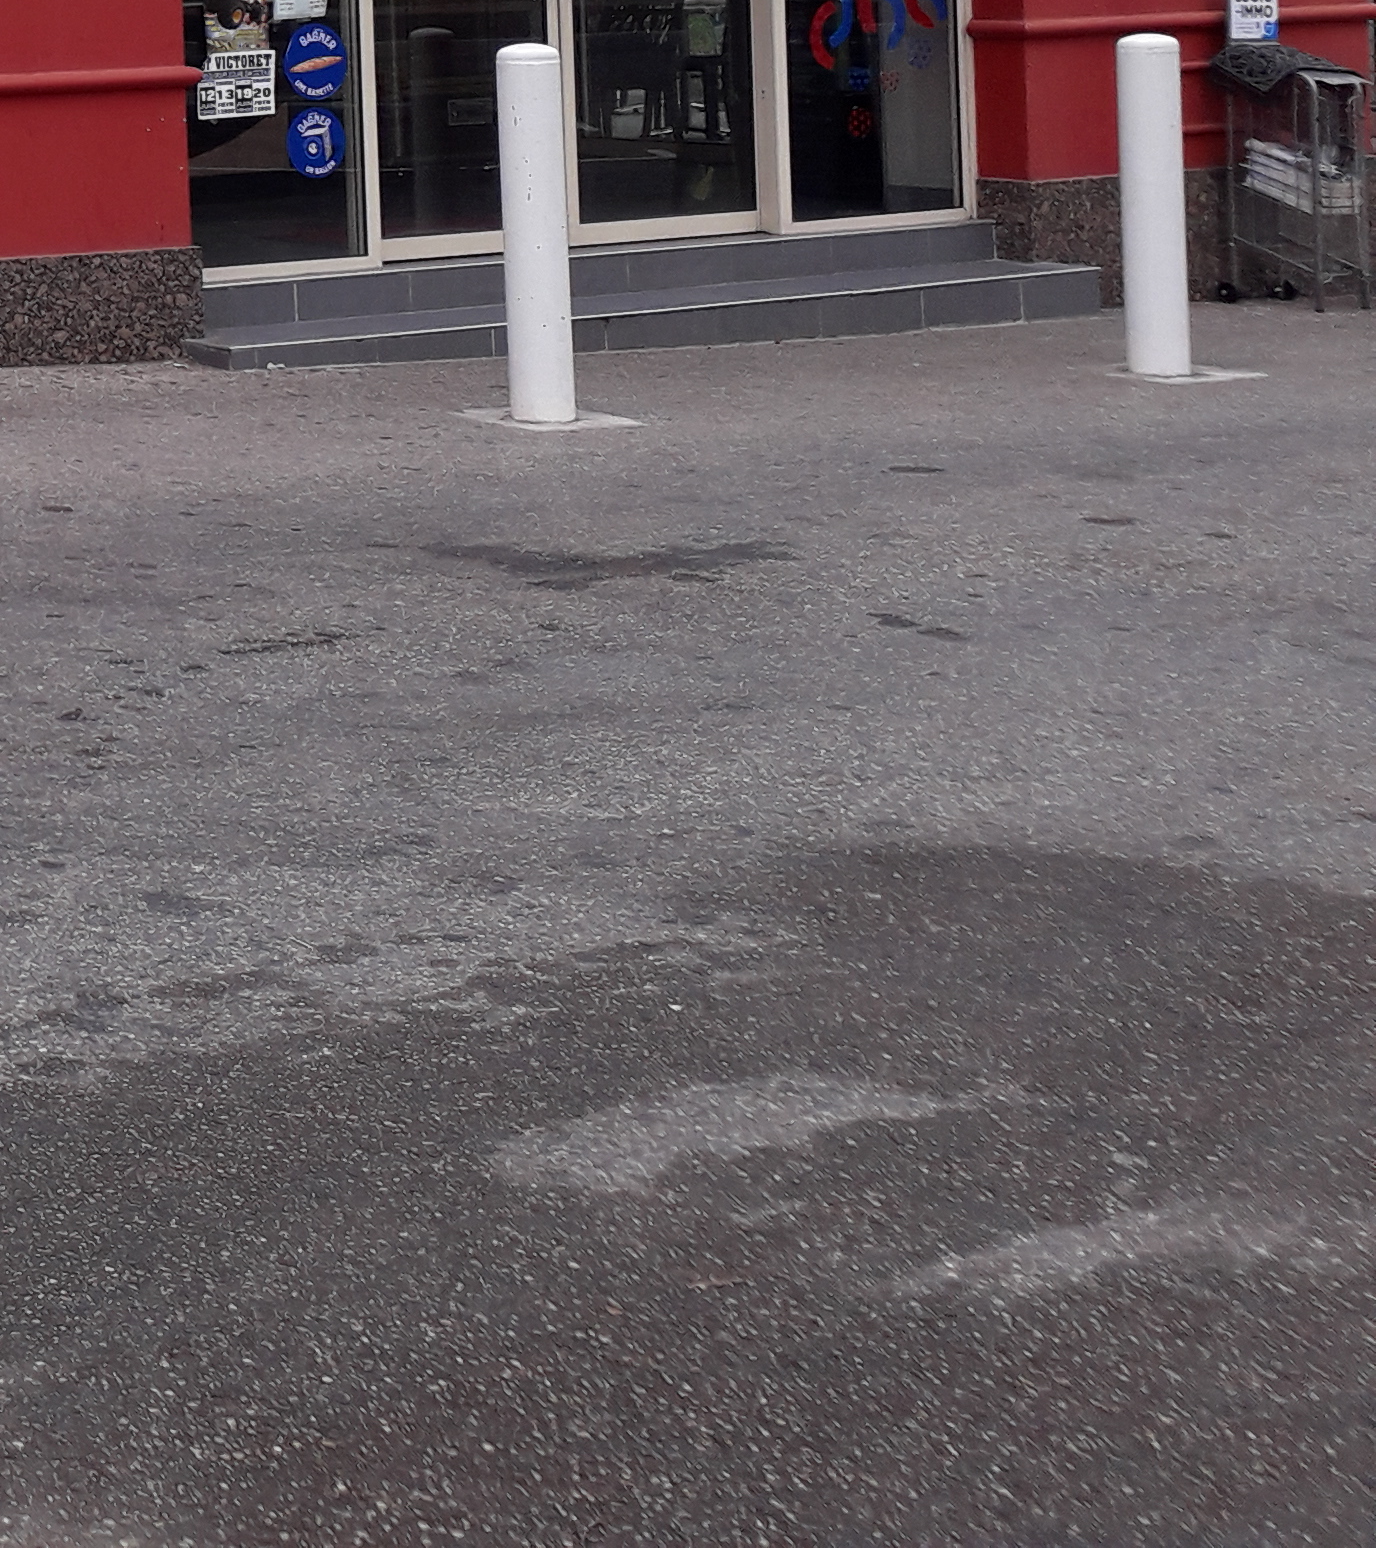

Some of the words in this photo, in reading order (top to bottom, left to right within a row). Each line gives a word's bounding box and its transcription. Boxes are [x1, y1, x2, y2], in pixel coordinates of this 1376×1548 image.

[214, 53, 272, 70] VICTORET
[200, 89, 215, 102] 12
[217, 88, 234, 101] 13
[253, 87, 271, 99] 20
